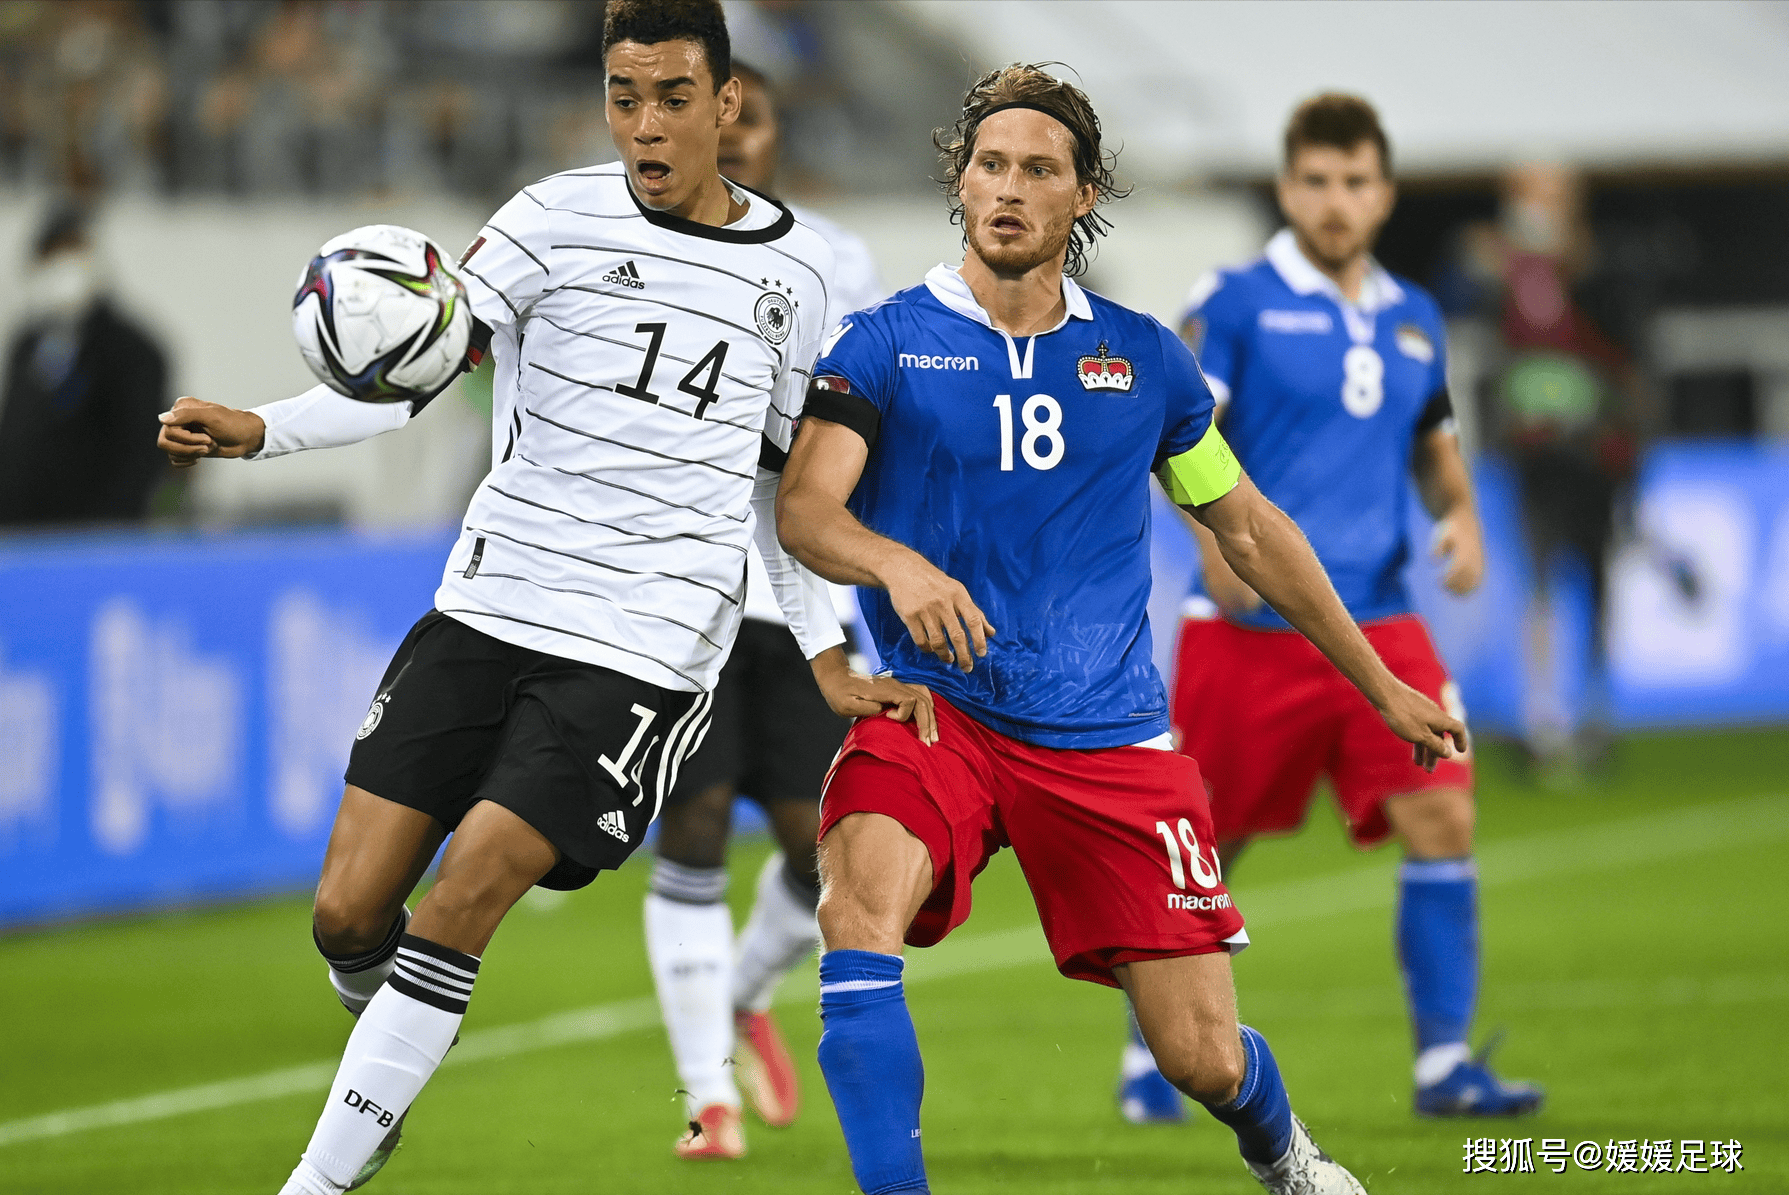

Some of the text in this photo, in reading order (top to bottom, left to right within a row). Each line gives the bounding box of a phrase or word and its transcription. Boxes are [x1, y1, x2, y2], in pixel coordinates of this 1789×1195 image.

[602, 274, 646, 290] adidas
[614, 322, 730, 421] 14
[898, 353, 979, 371] macron
[1342, 345, 1384, 419] 8
[993, 393, 1065, 471] 18
[596, 816, 630, 843] adidas
[1156, 817, 1219, 890] 18
[1167, 892, 1233, 911] macron
[343, 1088, 394, 1128] DFB
